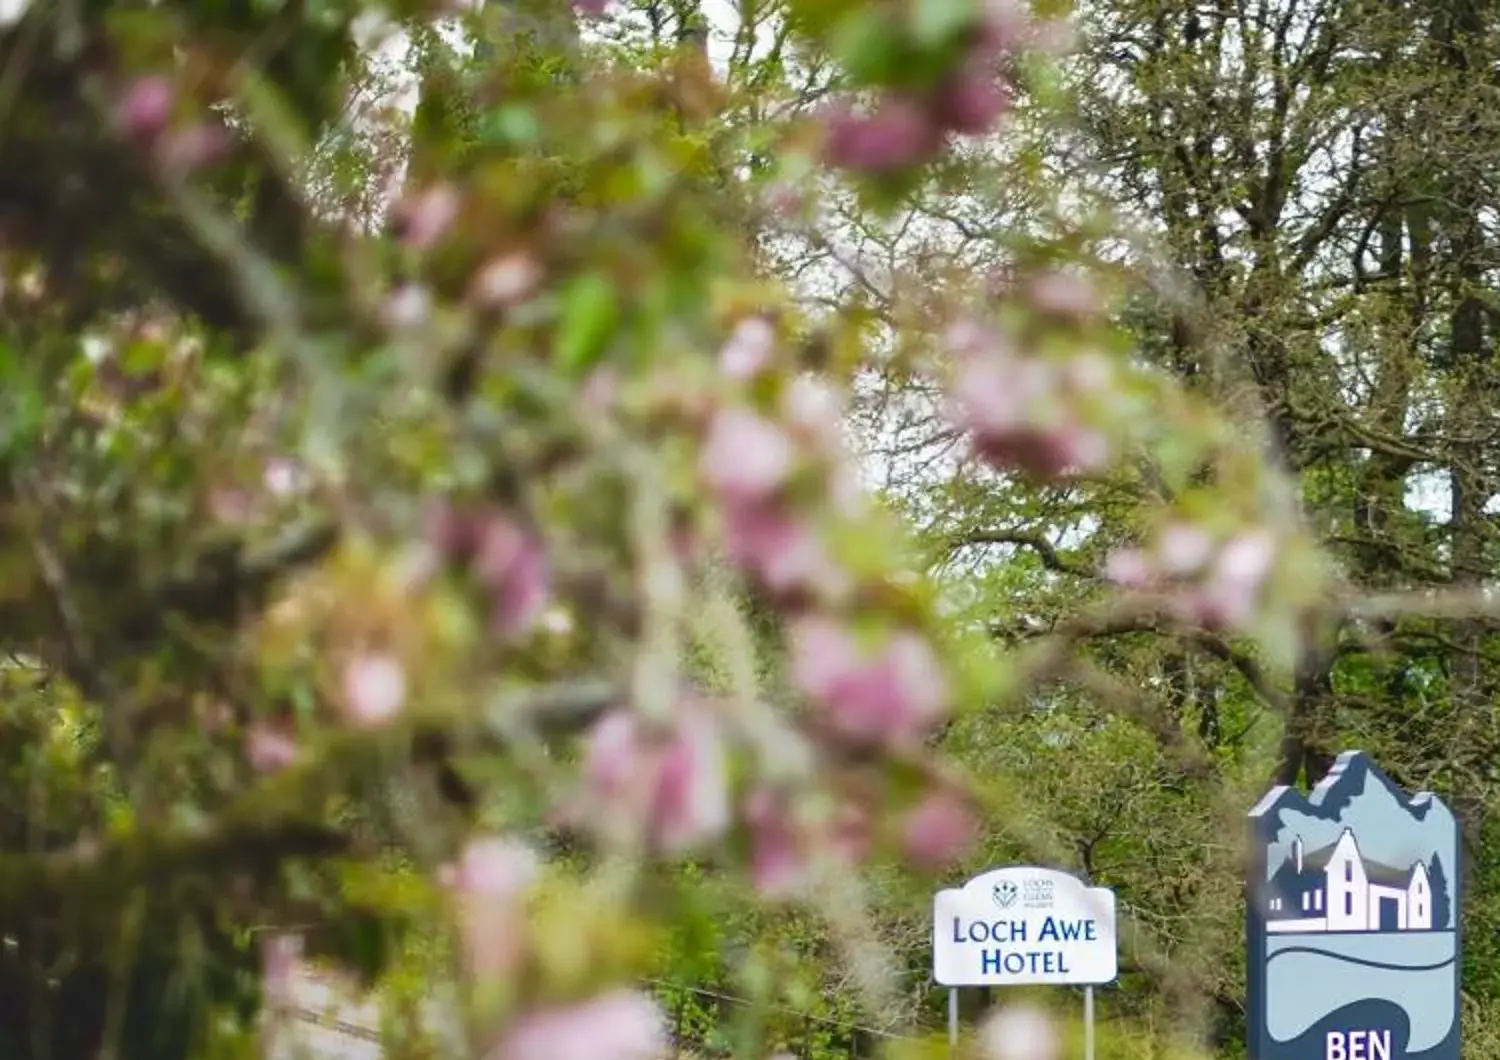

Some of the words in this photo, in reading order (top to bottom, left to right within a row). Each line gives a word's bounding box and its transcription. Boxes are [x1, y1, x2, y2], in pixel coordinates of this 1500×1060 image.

[953, 916, 1027, 943] LOCH
[1038, 916, 1097, 941] AWE
[981, 949, 1070, 975] HOTEL
